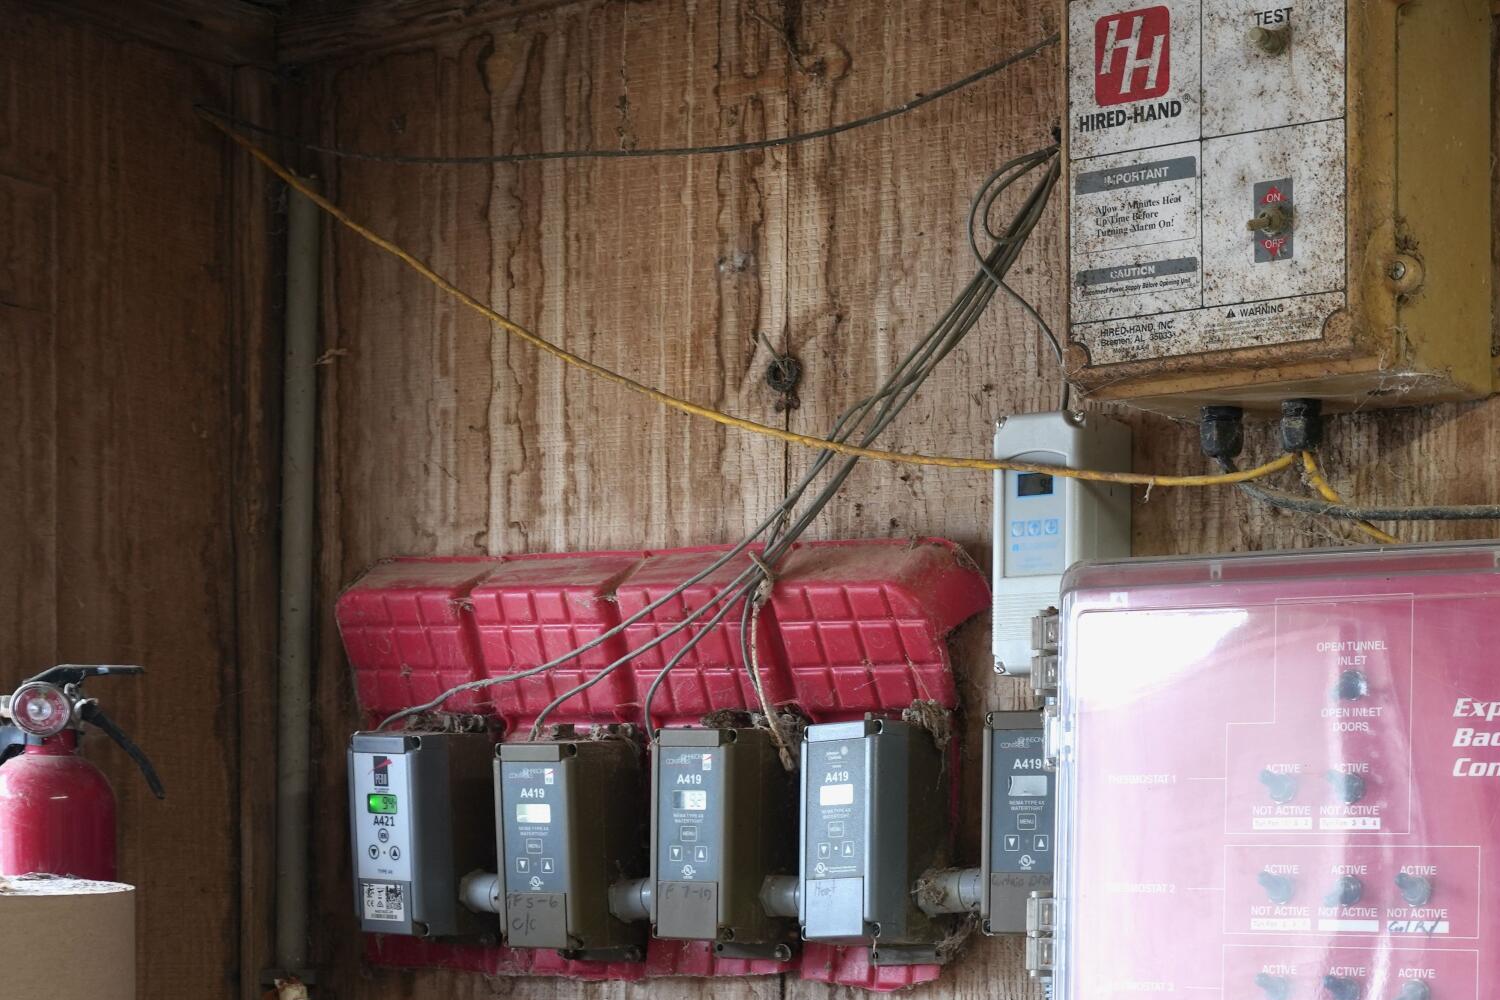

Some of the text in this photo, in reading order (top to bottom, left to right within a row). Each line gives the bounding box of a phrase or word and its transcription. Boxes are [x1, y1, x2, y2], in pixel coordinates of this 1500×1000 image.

[1254, 8, 1292, 26] TEST
[1079, 100, 1182, 133] HIRED-HAND
[1104, 167, 1169, 184] IMPORTANT
[1128, 198, 1160, 209] Minutes
[1163, 195, 1181, 204] Heat
[1266, 192, 1281, 203] ON
[1133, 211, 1159, 221] Before
[1097, 226, 1129, 238] Turning
[1159, 219, 1174, 228] On!
[1264, 239, 1285, 249] OFF
[1110, 265, 1155, 279] CAUTION
[1239, 304, 1285, 317] WARNING
[1316, 640, 1388, 653] OPEN TUNNEL
[1337, 655, 1367, 666] INLET
[1321, 706, 1382, 718] OPEN INLET
[1332, 721, 1370, 733] DOORS
[1013, 759, 1042, 769] A419
[1265, 763, 1300, 774] ACTIVE
[677, 774, 702, 784] A419
[825, 771, 849, 783] A419
[520, 788, 545, 798] A419
[1252, 805, 1311, 817] NOT ACTIVE
[1319, 805, 1380, 817] NOT ACTIVE
[373, 816, 395, 827] A421
